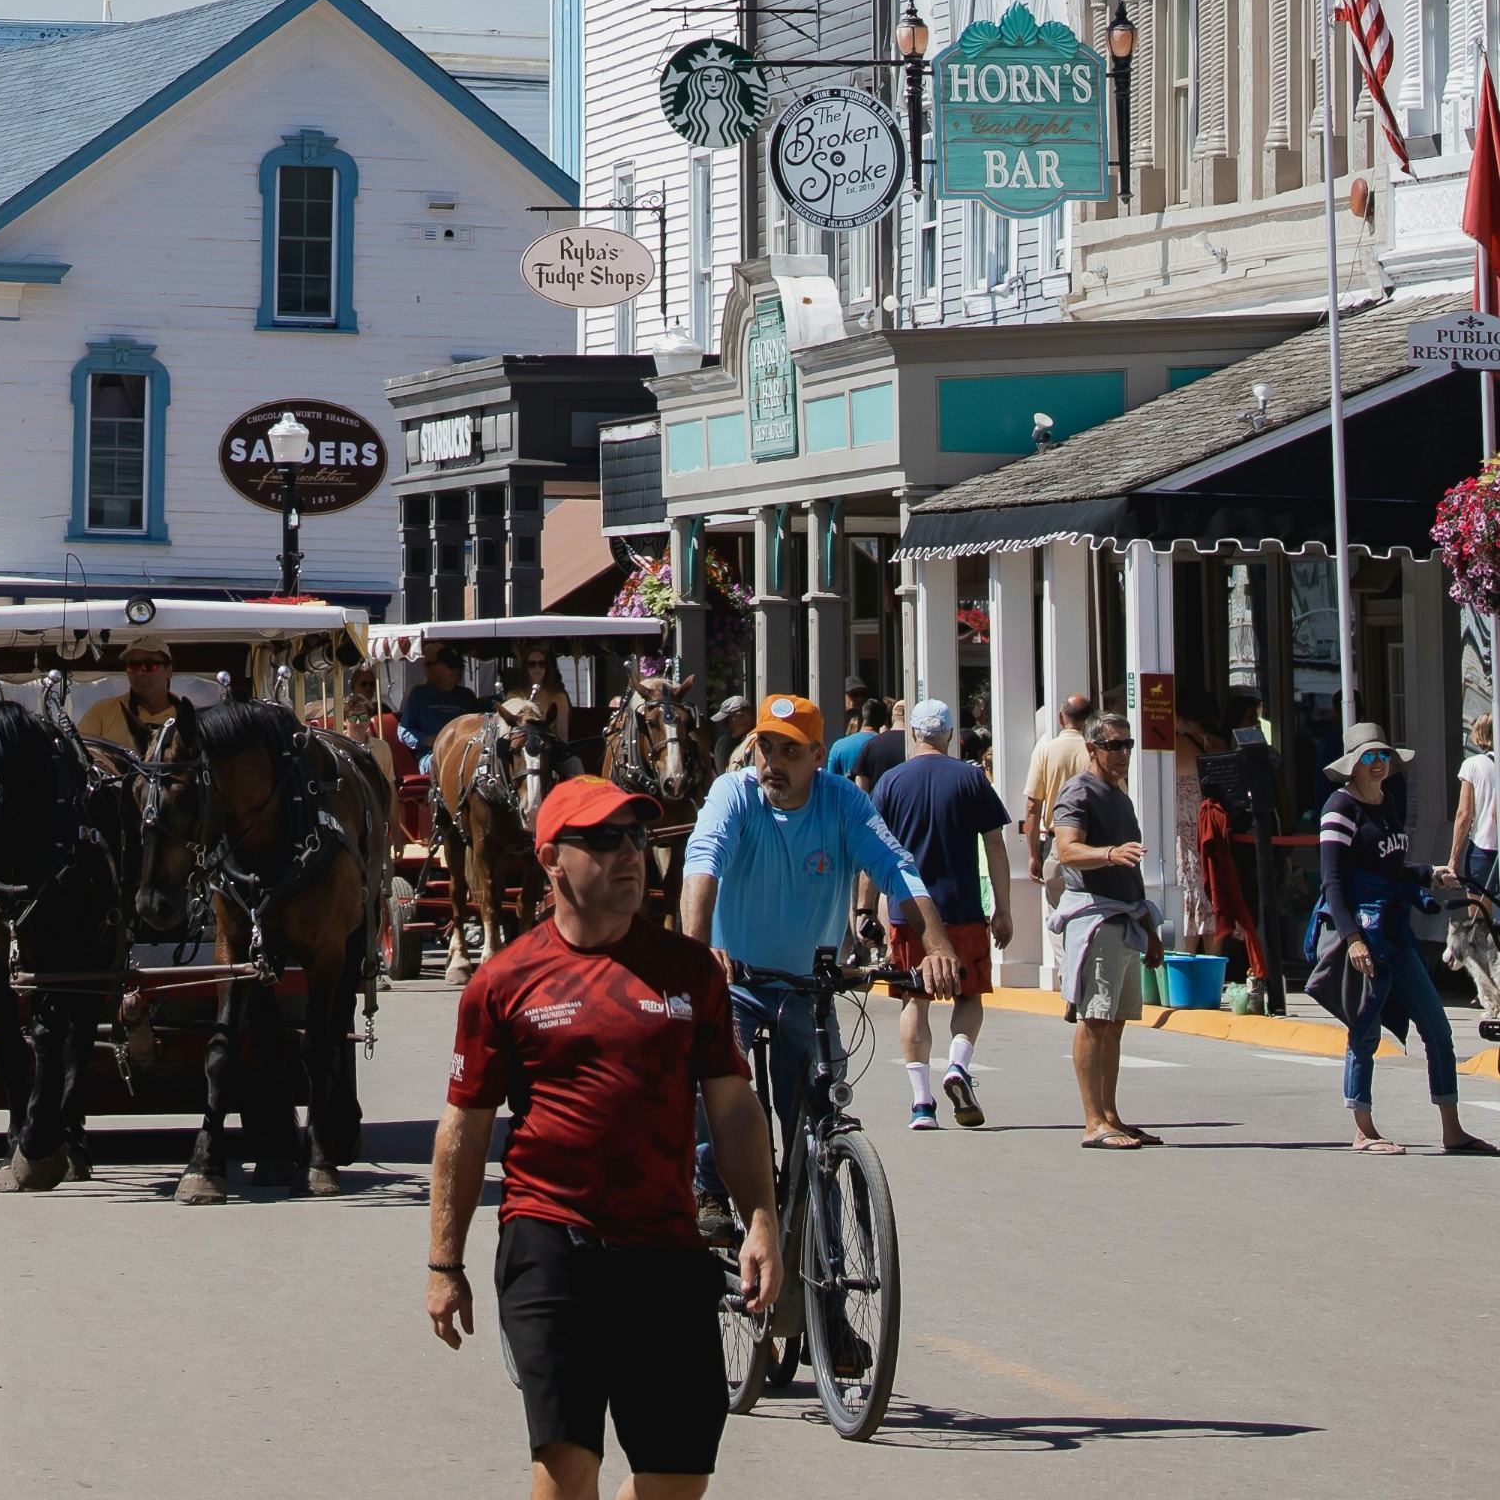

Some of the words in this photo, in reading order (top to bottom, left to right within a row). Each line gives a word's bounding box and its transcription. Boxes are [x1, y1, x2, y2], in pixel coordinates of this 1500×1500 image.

[948, 63, 1093, 104] HORN'S
[780, 100, 806, 126] WHISKEY
[812, 89, 831, 100] WINE
[840, 89, 873, 106] BOURBON
[877, 109, 895, 127] BEER
[813, 105, 842, 125] The
[785, 112, 879, 166] Broken
[969, 113, 1075, 143] Gaslight
[800, 145, 887, 218] Spoke
[983, 149, 1064, 189] BAR
[846, 186, 858, 194] Est.
[858, 182, 876, 192] 2019
[792, 202, 826, 225] MACKINAC
[827, 219, 853, 228] ISLAND
[854, 202, 887, 225] MICHIGAN
[560, 236, 619, 267] Ryba's
[532, 263, 585, 291] Fudge
[590, 265, 646, 291] Shops
[753, 337, 787, 368] HORN'S
[762, 380, 781, 409] BAR
[296, 410, 322, 419] WORTH
[325, 413, 360, 428] SHARING
[230, 438, 378, 467] SADERS
[421, 415, 472, 462] STARBUCKS
